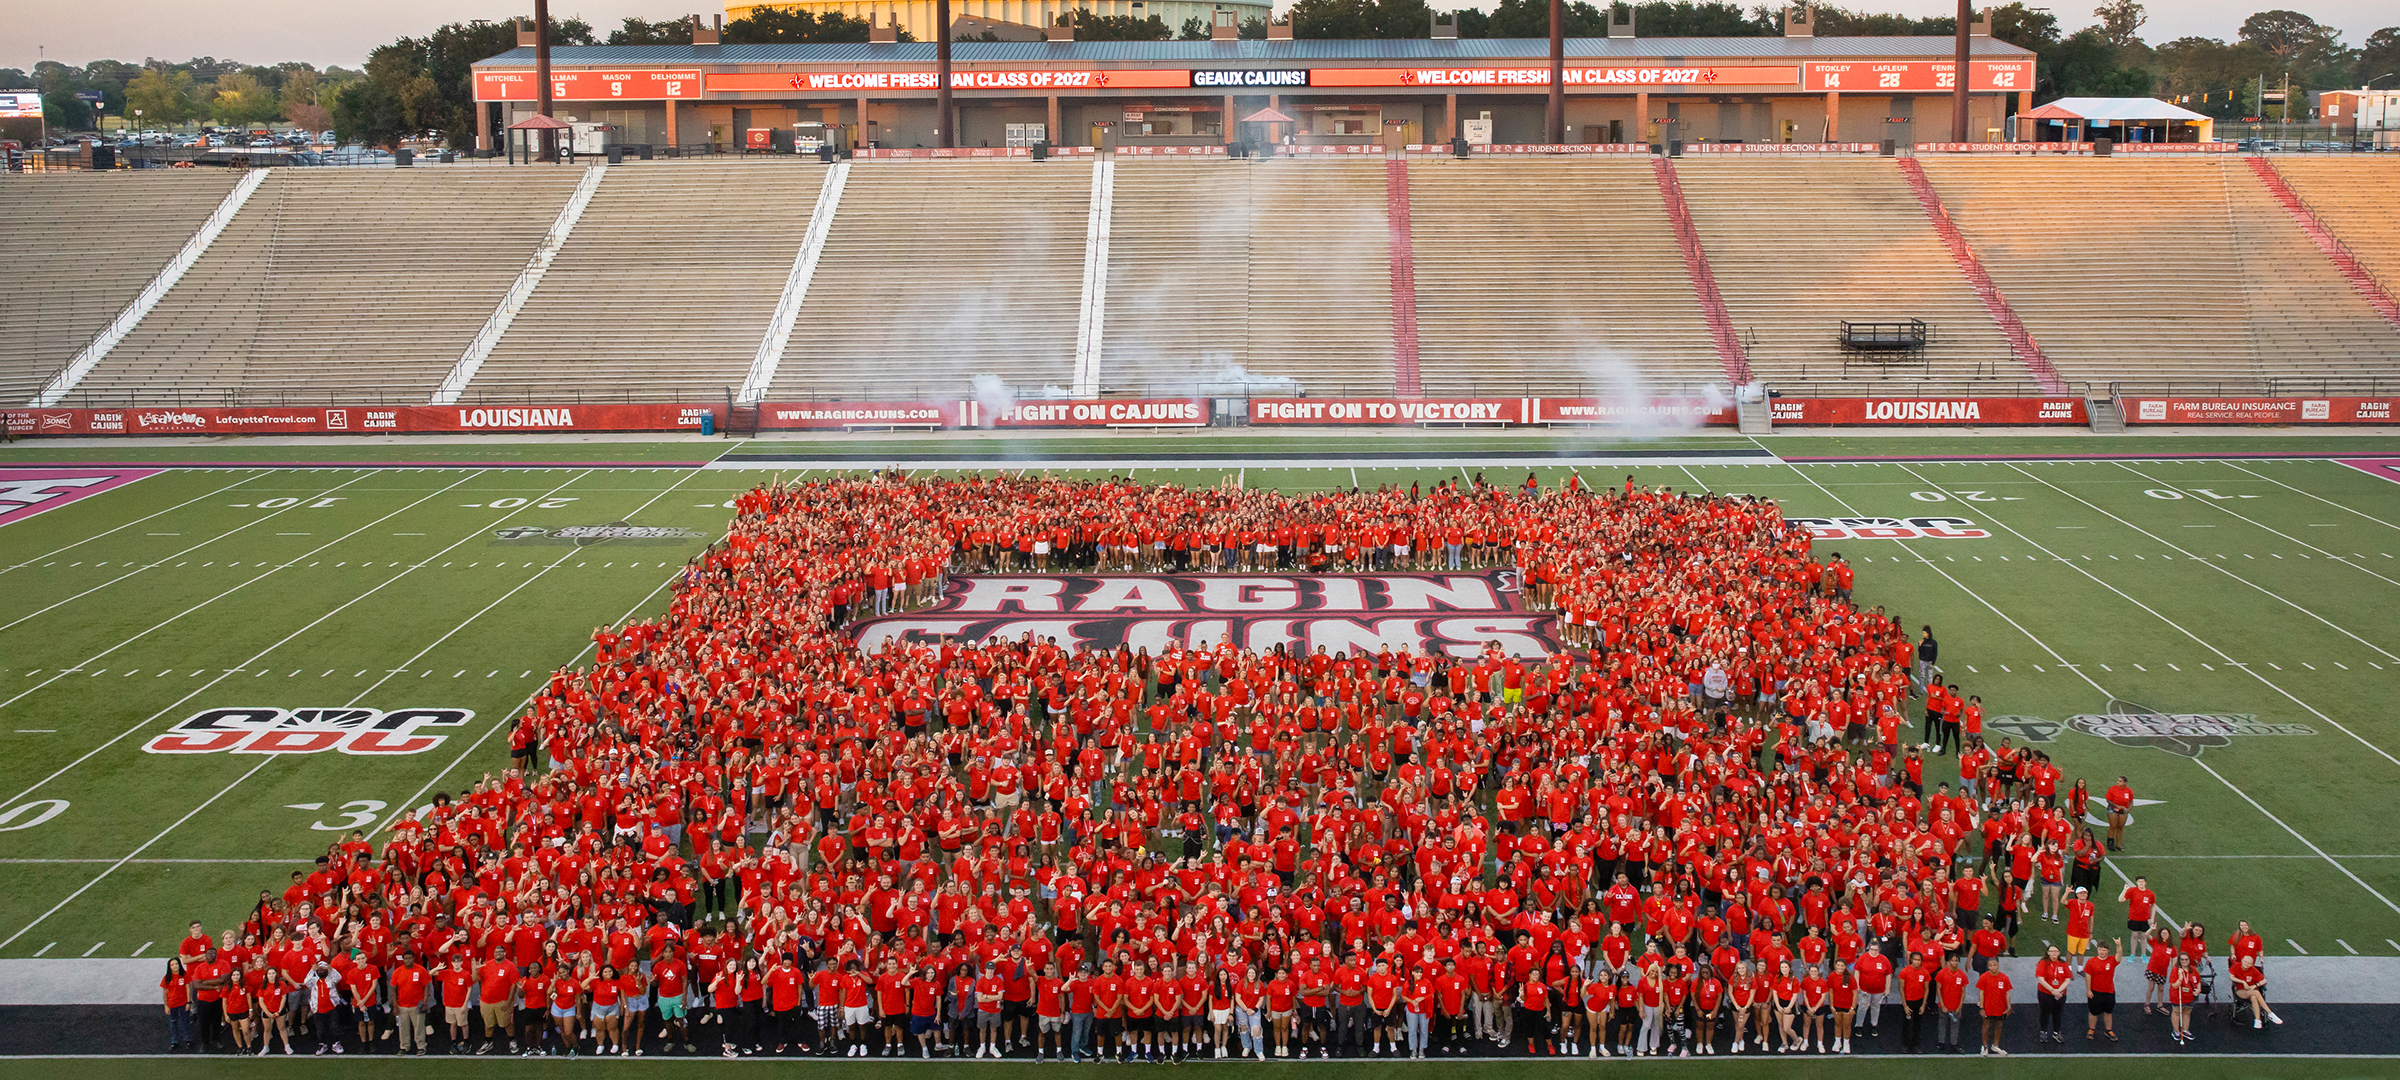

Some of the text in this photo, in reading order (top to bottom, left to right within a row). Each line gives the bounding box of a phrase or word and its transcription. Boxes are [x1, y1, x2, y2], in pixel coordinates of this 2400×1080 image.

[809, 72, 1090, 88] WELCOME FRESHAN CLASS OF 2027
[1194, 71, 1306, 85] GEAUX CAJUNS!
[1417, 69, 1699, 84] WELCOME FRESHAN CLASS OF 2027
[1825, 73, 1840, 88] 14
[1880, 73, 1900, 87] 28
[1936, 73, 1955, 86] 32
[1993, 73, 2014, 87] 42
[501, 83, 506, 97] 1
[556, 83, 566, 97] 5
[611, 82, 622, 96] 9
[666, 82, 681, 96] 12
[776, 409, 939, 420] WWW.RAGINCAJUNS.COM
[1001, 403, 1199, 420] FIGHT ON CAJUNS
[1258, 403, 1502, 419] FIGHT ON TO VICTORY
[1865, 402, 1980, 419] LOUISIANA
[2039, 410, 2072, 418] CAJUNS
[2356, 410, 2390, 418] CAJUNS
[216, 415, 316, 425] LafayetteTravel.com
[364, 419, 396, 427] CAJUNS
[460, 409, 573, 427] LOUISIANA
[678, 417, 702, 425] CAJU
[2077, 714, 2258, 725] OUR LADY
[2092, 724, 2317, 736] OF LOURDES
